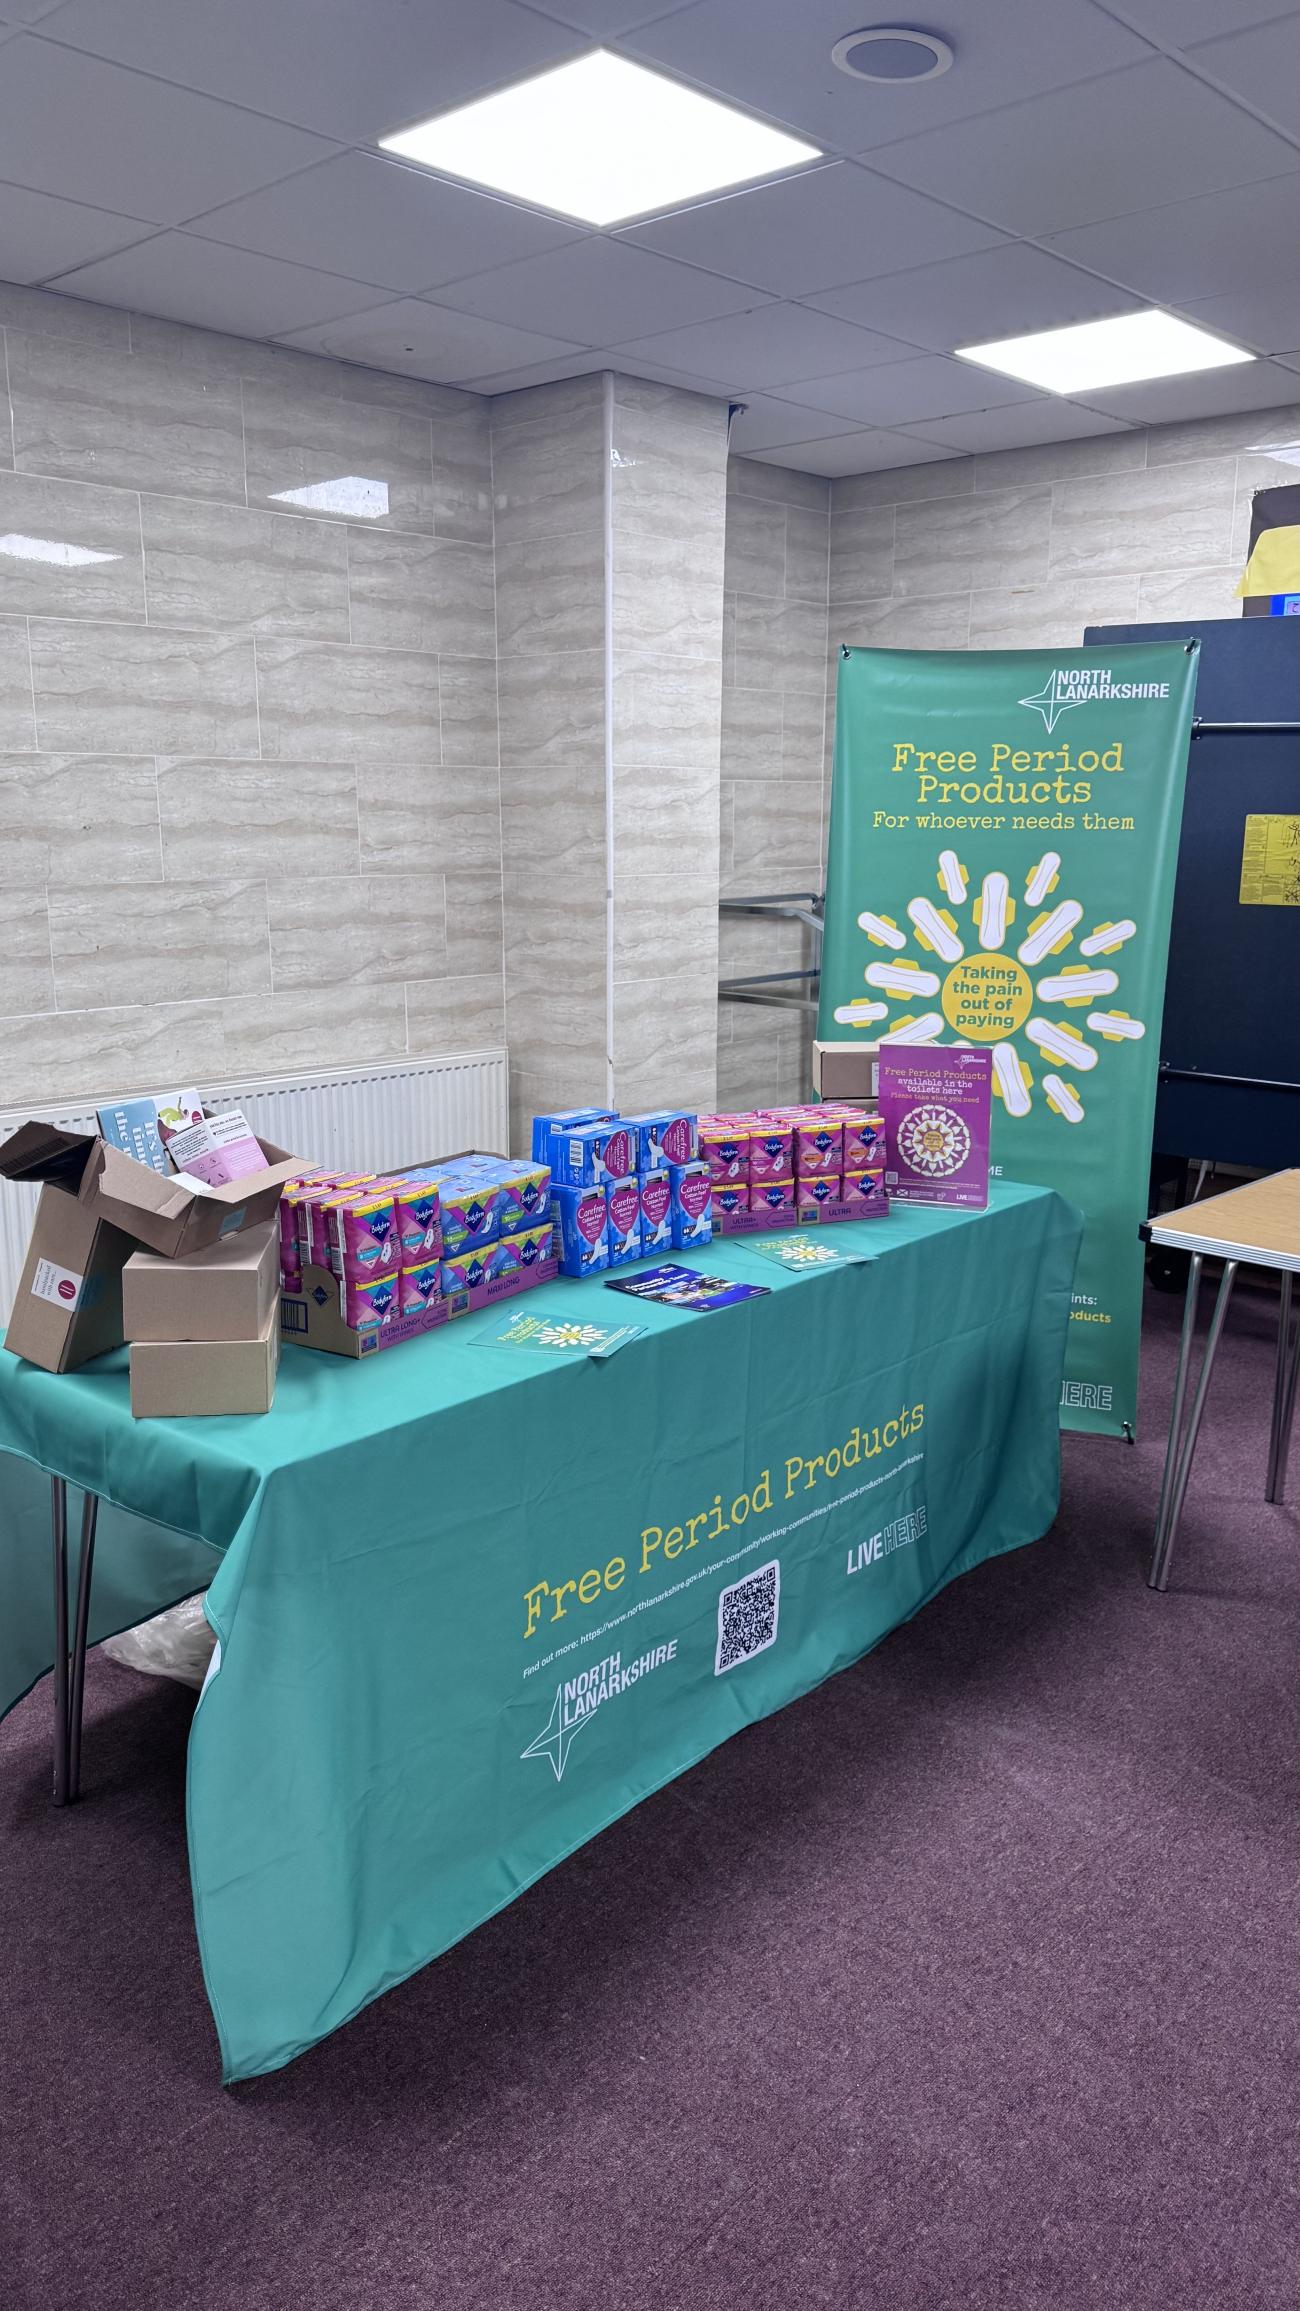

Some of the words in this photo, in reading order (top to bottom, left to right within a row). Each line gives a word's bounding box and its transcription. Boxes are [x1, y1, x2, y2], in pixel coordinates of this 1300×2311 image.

[1057, 669, 1111, 685] NORTH
[1056, 683, 1170, 700] LANARKSHIRE
[891, 743, 977, 773] Free
[989, 742, 1125, 773] Period
[917, 774, 1092, 804] Products
[872, 811, 909, 829] For
[915, 812, 1006, 830] whoever
[1011, 812, 1075, 830] needs
[1082, 812, 1135, 830] them
[960, 966, 1018, 982] Taking
[953, 981, 981, 994] the
[985, 982, 1023, 997] pain
[960, 998, 990, 1010] out
[994, 998, 1013, 1011] of
[956, 1013, 1015, 1029] paying
[884, 1067, 906, 1076] Free
[908, 1068, 941, 1078] Period
[943, 1070, 987, 1080] Products
[898, 1078, 942, 1087] available
[957, 1080, 973, 1088] the
[907, 1085, 940, 1093] toilets
[942, 1086, 963, 1095] here
[114, 1111, 129, 1143] the
[679, 1119, 687, 1160] Carefree
[619, 1131, 627, 1175] Carefree
[642, 1188, 670, 1201] Carefree
[680, 1182, 710, 1194] Carefree
[610, 1195, 639, 1210] Carefree
[415, 1208, 434, 1220] Bodyform
[464, 1211, 485, 1224] Bodyform
[577, 1204, 606, 1219] Carefree
[828, 1207, 852, 1216] ULTRA
[371, 1222, 391, 1234] Bodyform
[520, 1248, 538, 1260] Bodyform
[465, 1269, 484, 1282] Bodyform
[418, 1278, 436, 1290] Bodyform
[487, 1284, 503, 1296] MAXI
[503, 1276, 521, 1289] LONG
[372, 1294, 392, 1307] Bodyform
[380, 1325, 400, 1338] ULTRA
[523, 1556, 626, 1640] Free
[639, 1469, 774, 1574] Period
[784, 1402, 925, 1499] Products
[847, 1532, 884, 1575] LIVE
[883, 1505, 928, 1555] HERE
[523, 1663, 540, 1679] Find
[541, 1653, 554, 1667] out
[555, 1641, 579, 1660] more:
[563, 1651, 622, 1704] NORTH
[563, 1639, 679, 1727] LANARKSHIRE
